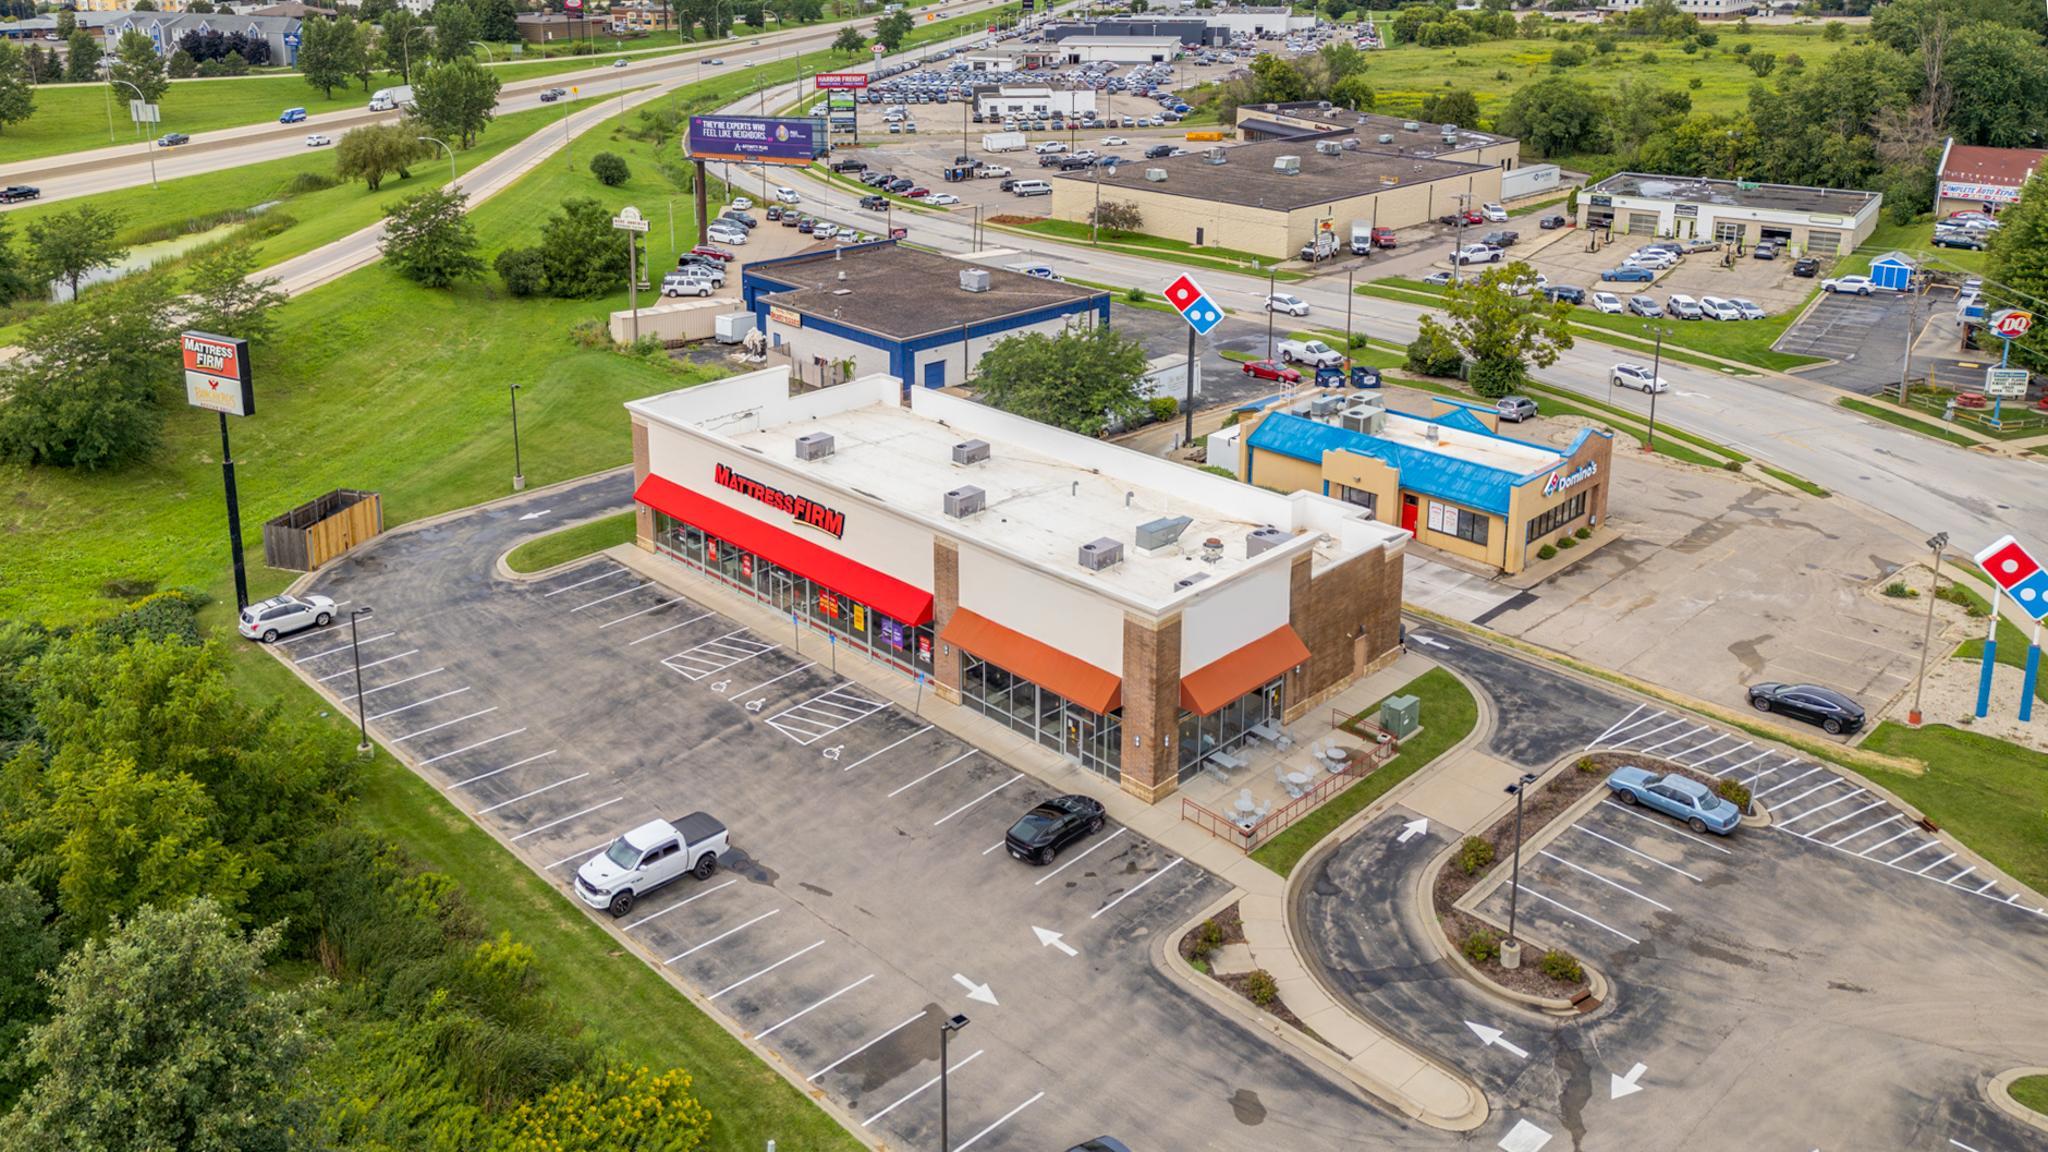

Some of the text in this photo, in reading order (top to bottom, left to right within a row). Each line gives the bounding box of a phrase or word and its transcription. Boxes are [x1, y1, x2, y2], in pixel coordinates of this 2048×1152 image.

[817, 75, 866, 83] HARBOR FREIGHT
[703, 128, 718, 138] FEEL
[718, 129, 732, 138] LIKE
[726, 121, 751, 131] EXPERTS
[752, 122, 766, 132] WHO
[1976, 186, 1996, 196] AUTO
[2002, 317, 2027, 332] DQ
[184, 337, 233, 359] MATTRESS
[196, 352, 224, 370] FIRM
[1558, 460, 1598, 492] Domino's
